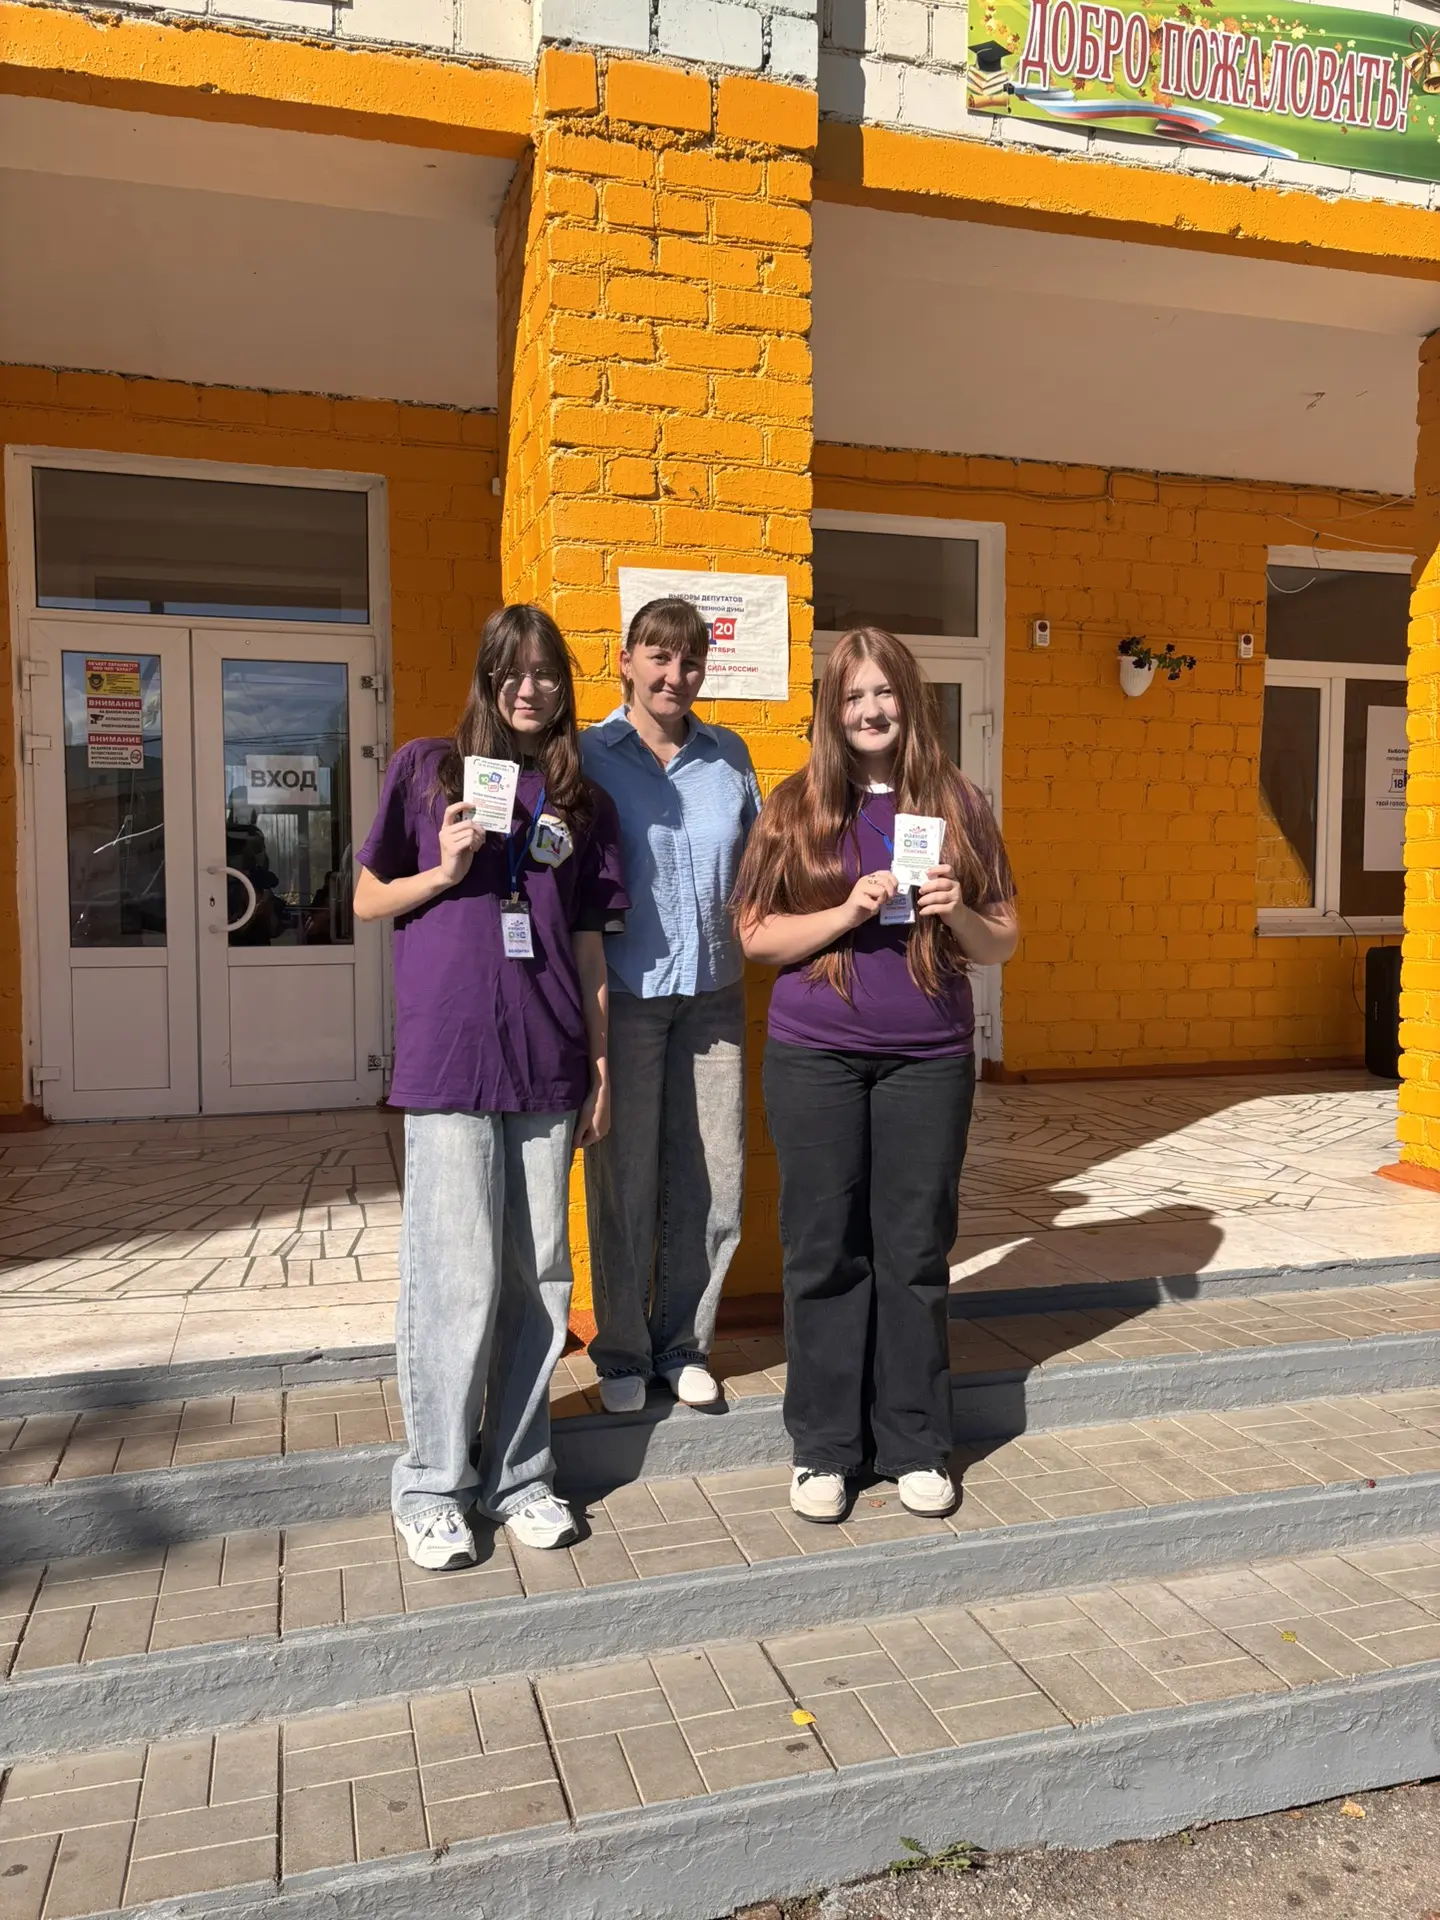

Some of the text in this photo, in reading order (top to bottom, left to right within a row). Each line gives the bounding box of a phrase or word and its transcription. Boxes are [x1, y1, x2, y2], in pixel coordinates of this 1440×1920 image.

[1021, 0, 1412, 132] ДОБРО ПОЖАЛОВАТЬ!
[668, 593, 743, 603] ВЫБОРЫ ДЕПУТАТОВ
[715, 623, 733, 635] 20
[707, 664, 759, 673] СИЛА РОССИИ!
[89, 699, 140, 708] ВНИМАНИЕ
[90, 735, 141, 744] ВНИМАНИЕ
[251, 770, 318, 791] ВХОД
[1393, 779, 1403, 788] 18
